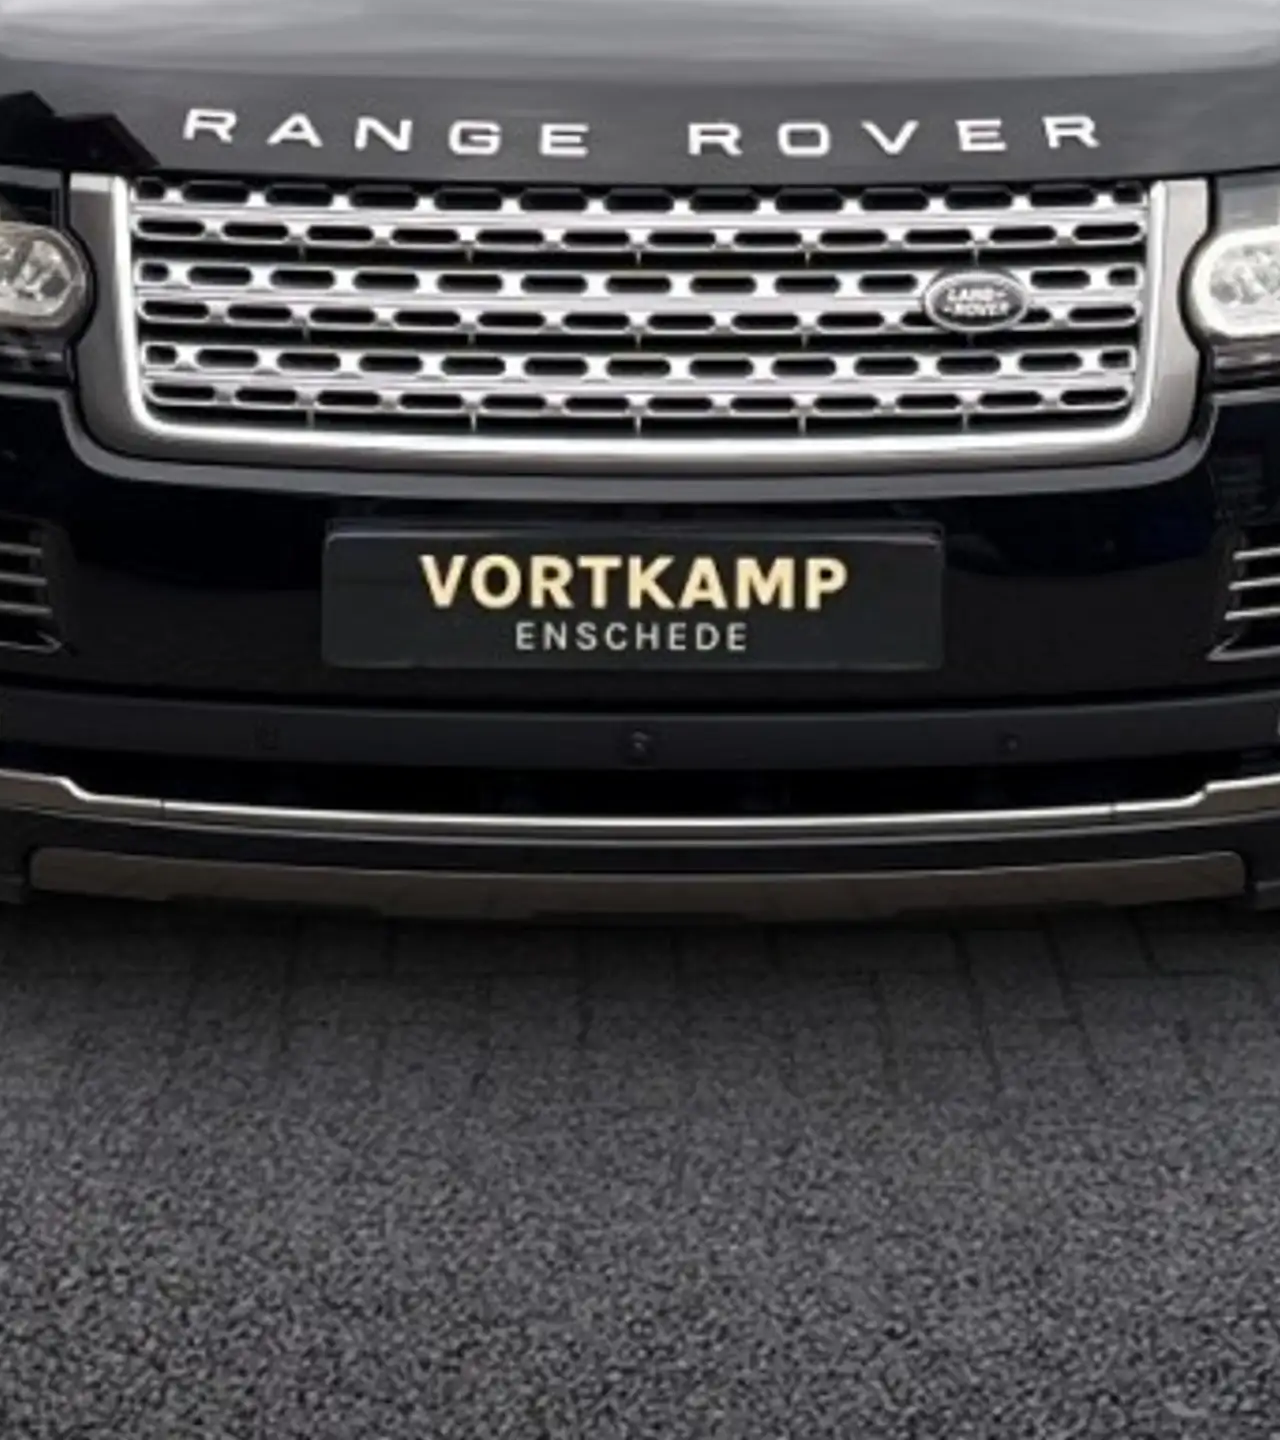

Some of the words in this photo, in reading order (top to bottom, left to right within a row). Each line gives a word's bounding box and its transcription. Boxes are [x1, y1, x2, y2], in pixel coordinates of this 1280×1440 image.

[182, 107, 590, 158] RANGE
[687, 113, 1100, 158] ROVER
[419, 553, 848, 610] VORTKAMP
[516, 622, 746, 650] ENSCHEDE
